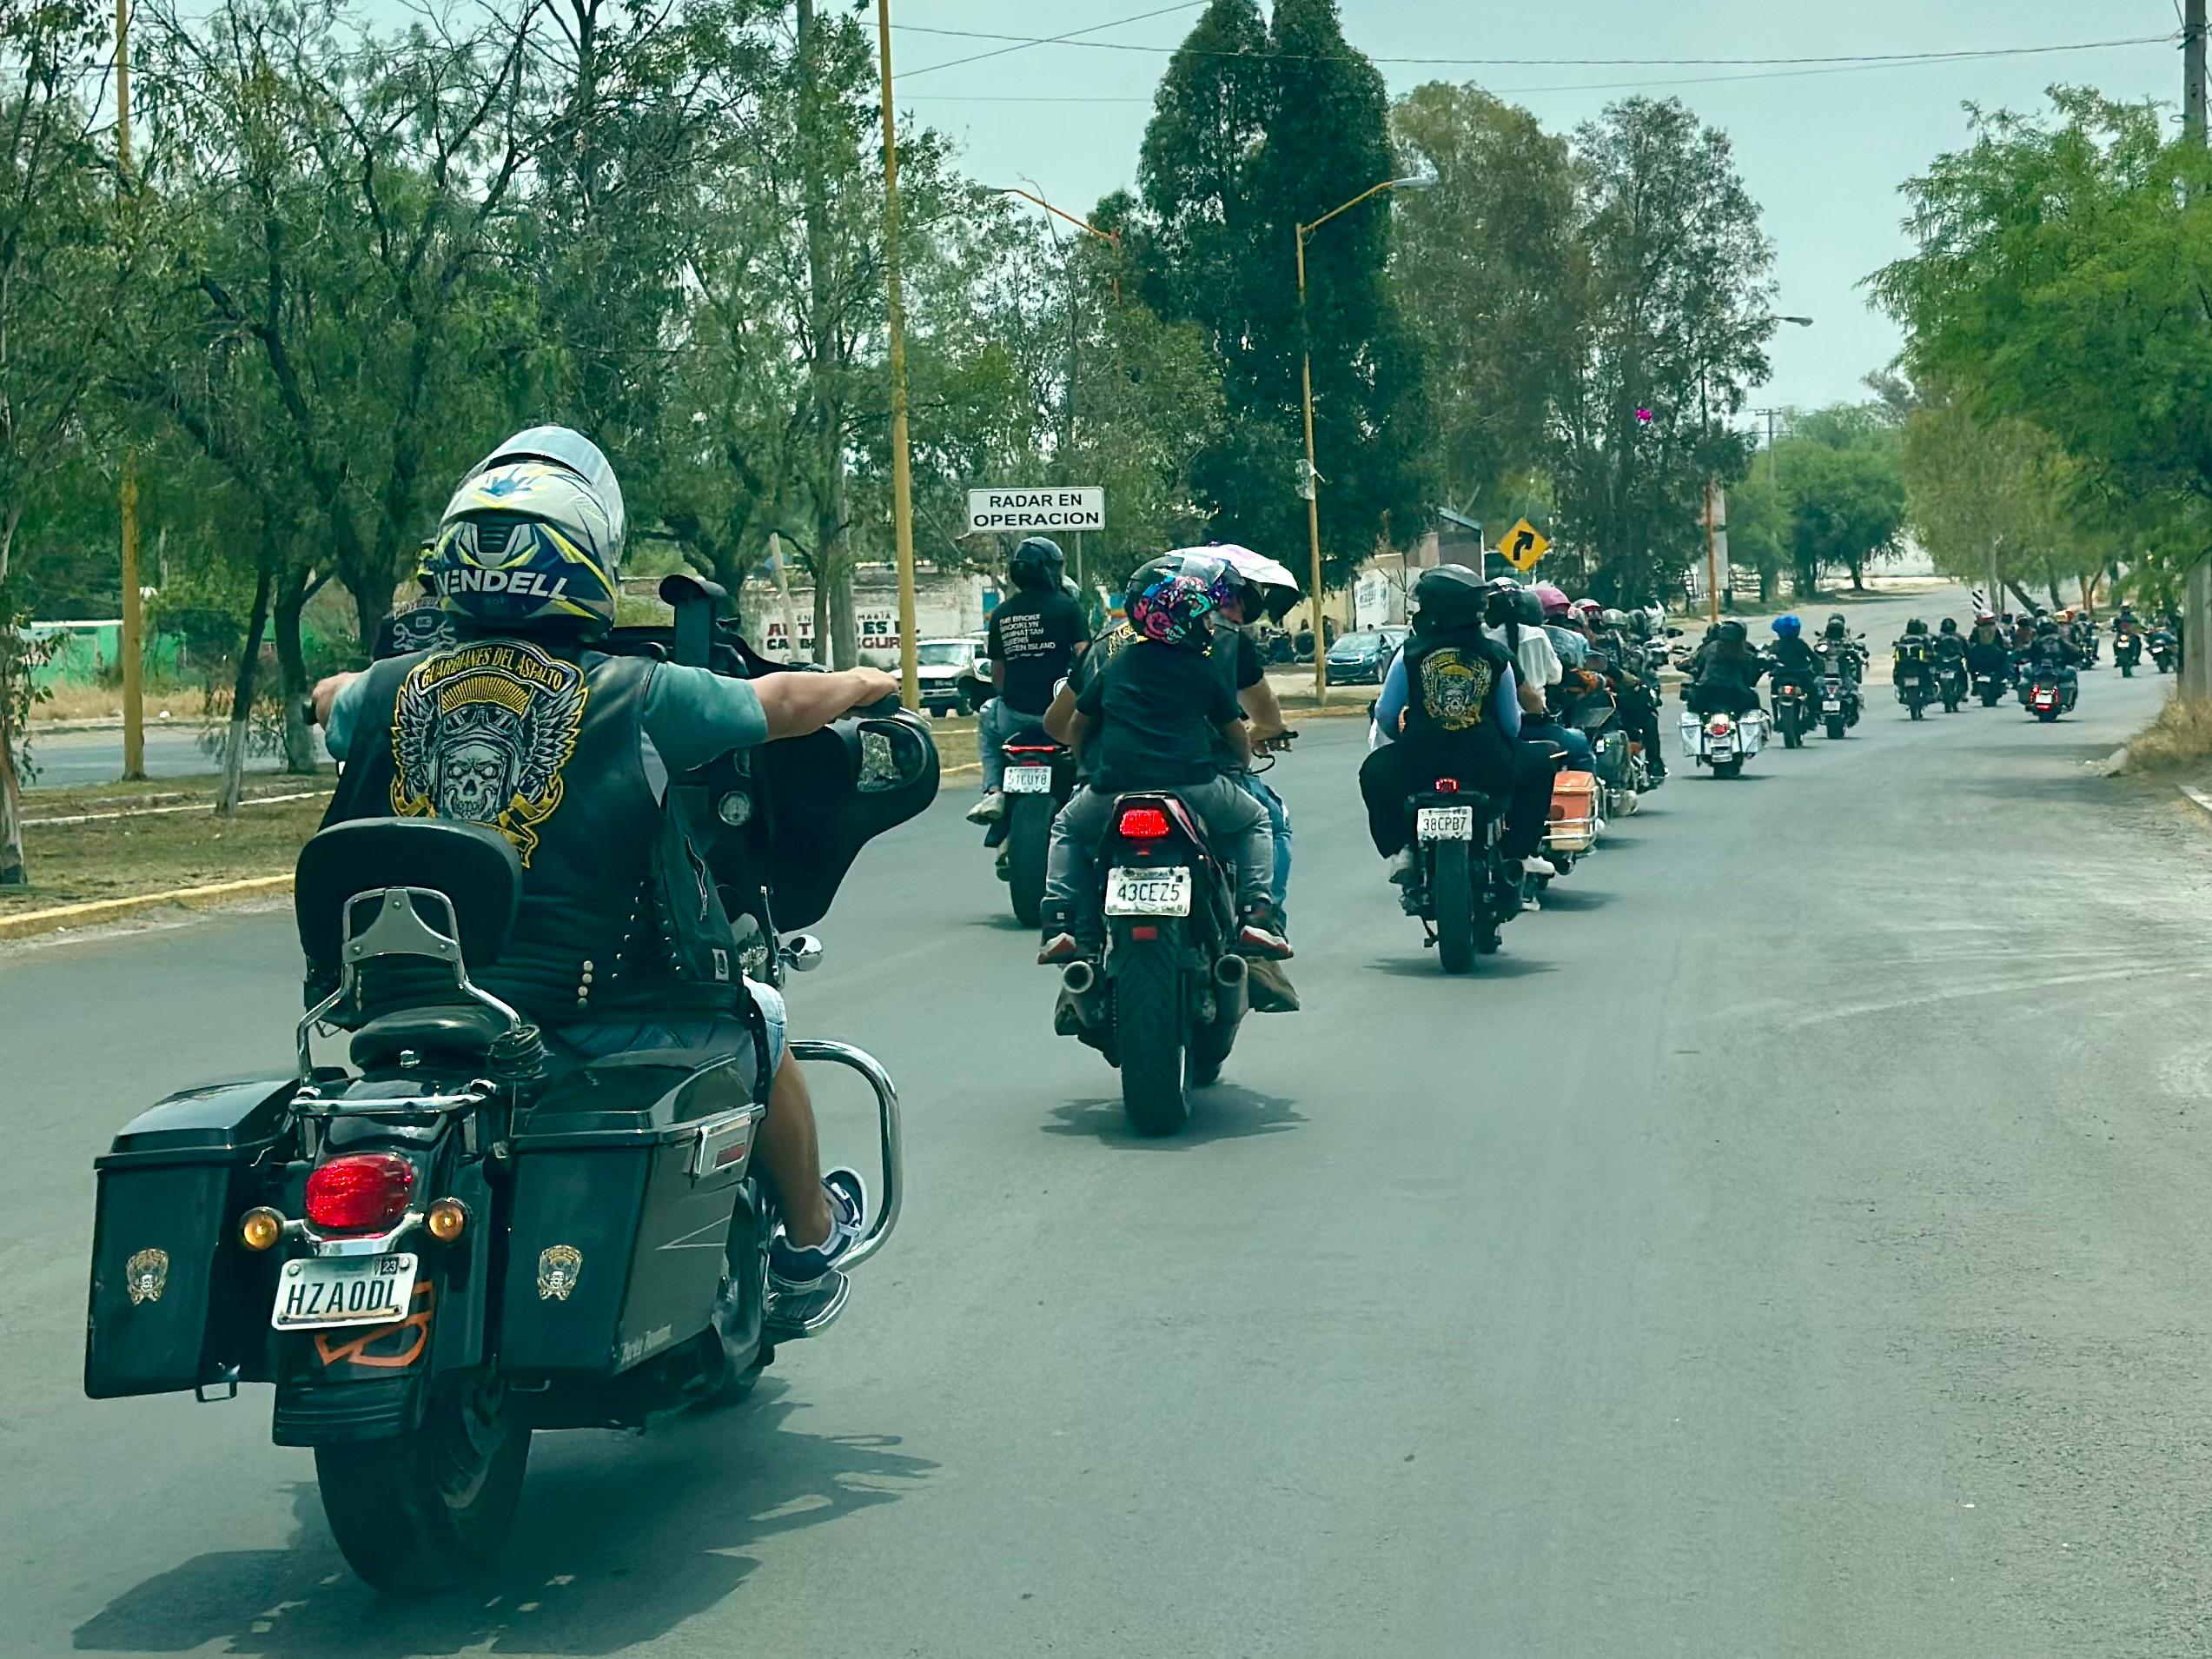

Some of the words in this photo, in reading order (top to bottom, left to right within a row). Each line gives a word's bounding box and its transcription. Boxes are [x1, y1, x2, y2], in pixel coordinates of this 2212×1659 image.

[990, 494, 1053, 508] RADAR
[1059, 494, 1082, 507] EN
[973, 512, 1099, 528] OPERACION
[492, 647, 514, 670] DEL
[516, 654, 563, 691] ASFALTO
[1423, 817, 1467, 831] 38CPB7
[1117, 882, 1181, 902] 43CEZ5
[381, 1260, 398, 1272] 23
